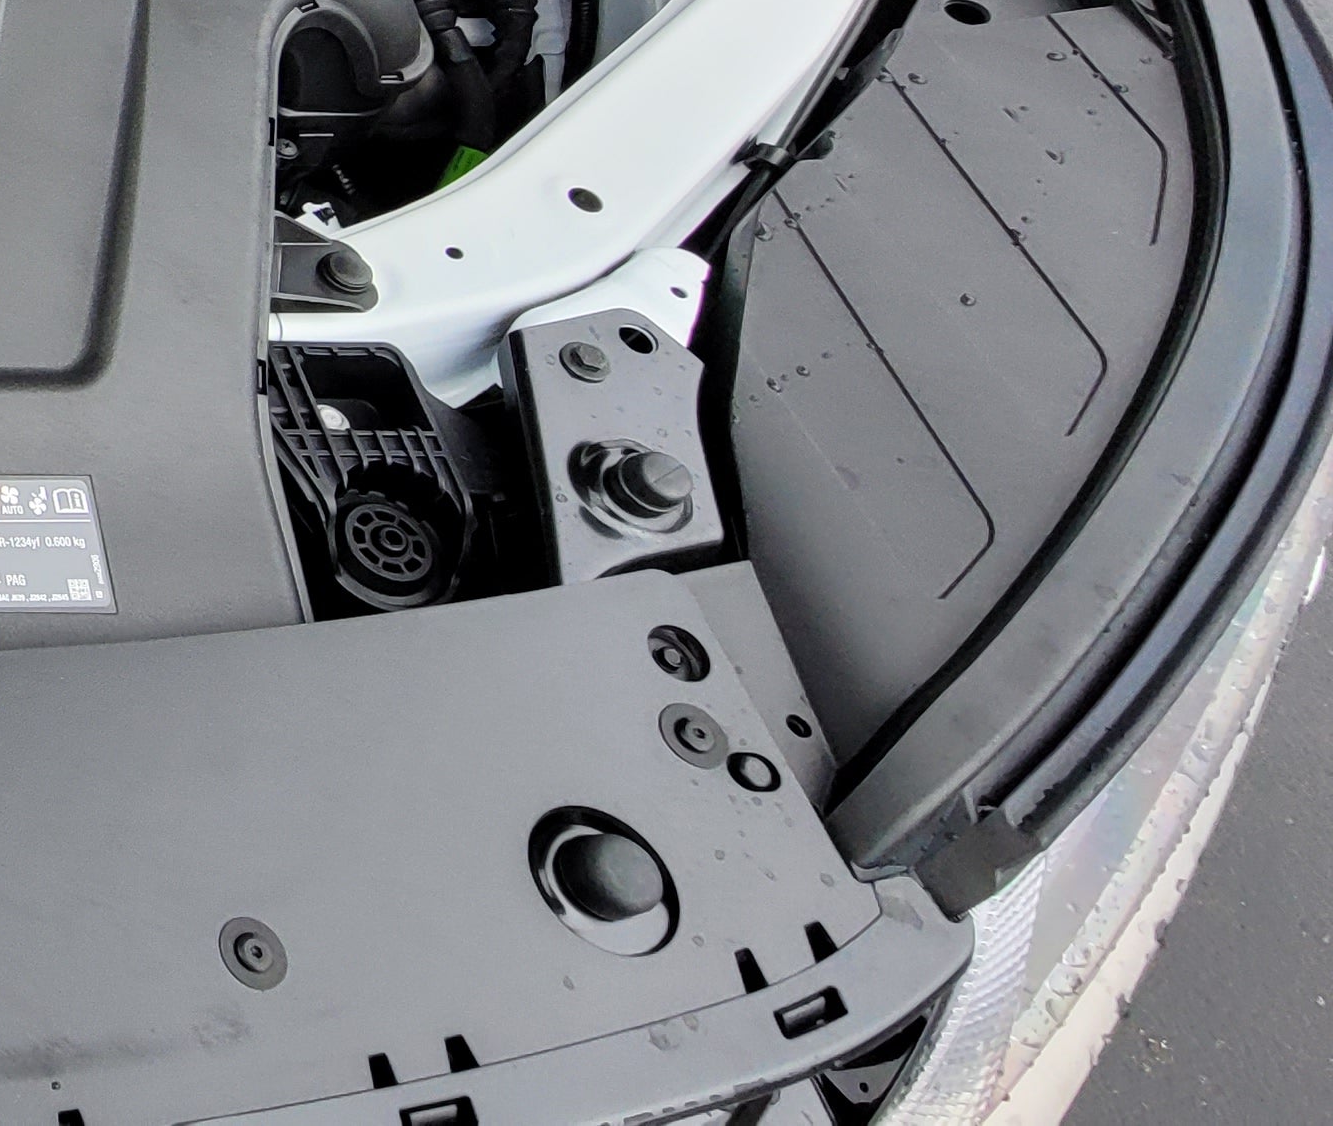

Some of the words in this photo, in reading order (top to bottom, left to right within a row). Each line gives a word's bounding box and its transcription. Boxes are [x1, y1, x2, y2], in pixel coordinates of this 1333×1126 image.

[1, 505, 24, 515] AUTO
[45, 536, 72, 548] 0.600
[73, 536, 86, 549] kg
[5, 574, 27, 587] PAG
